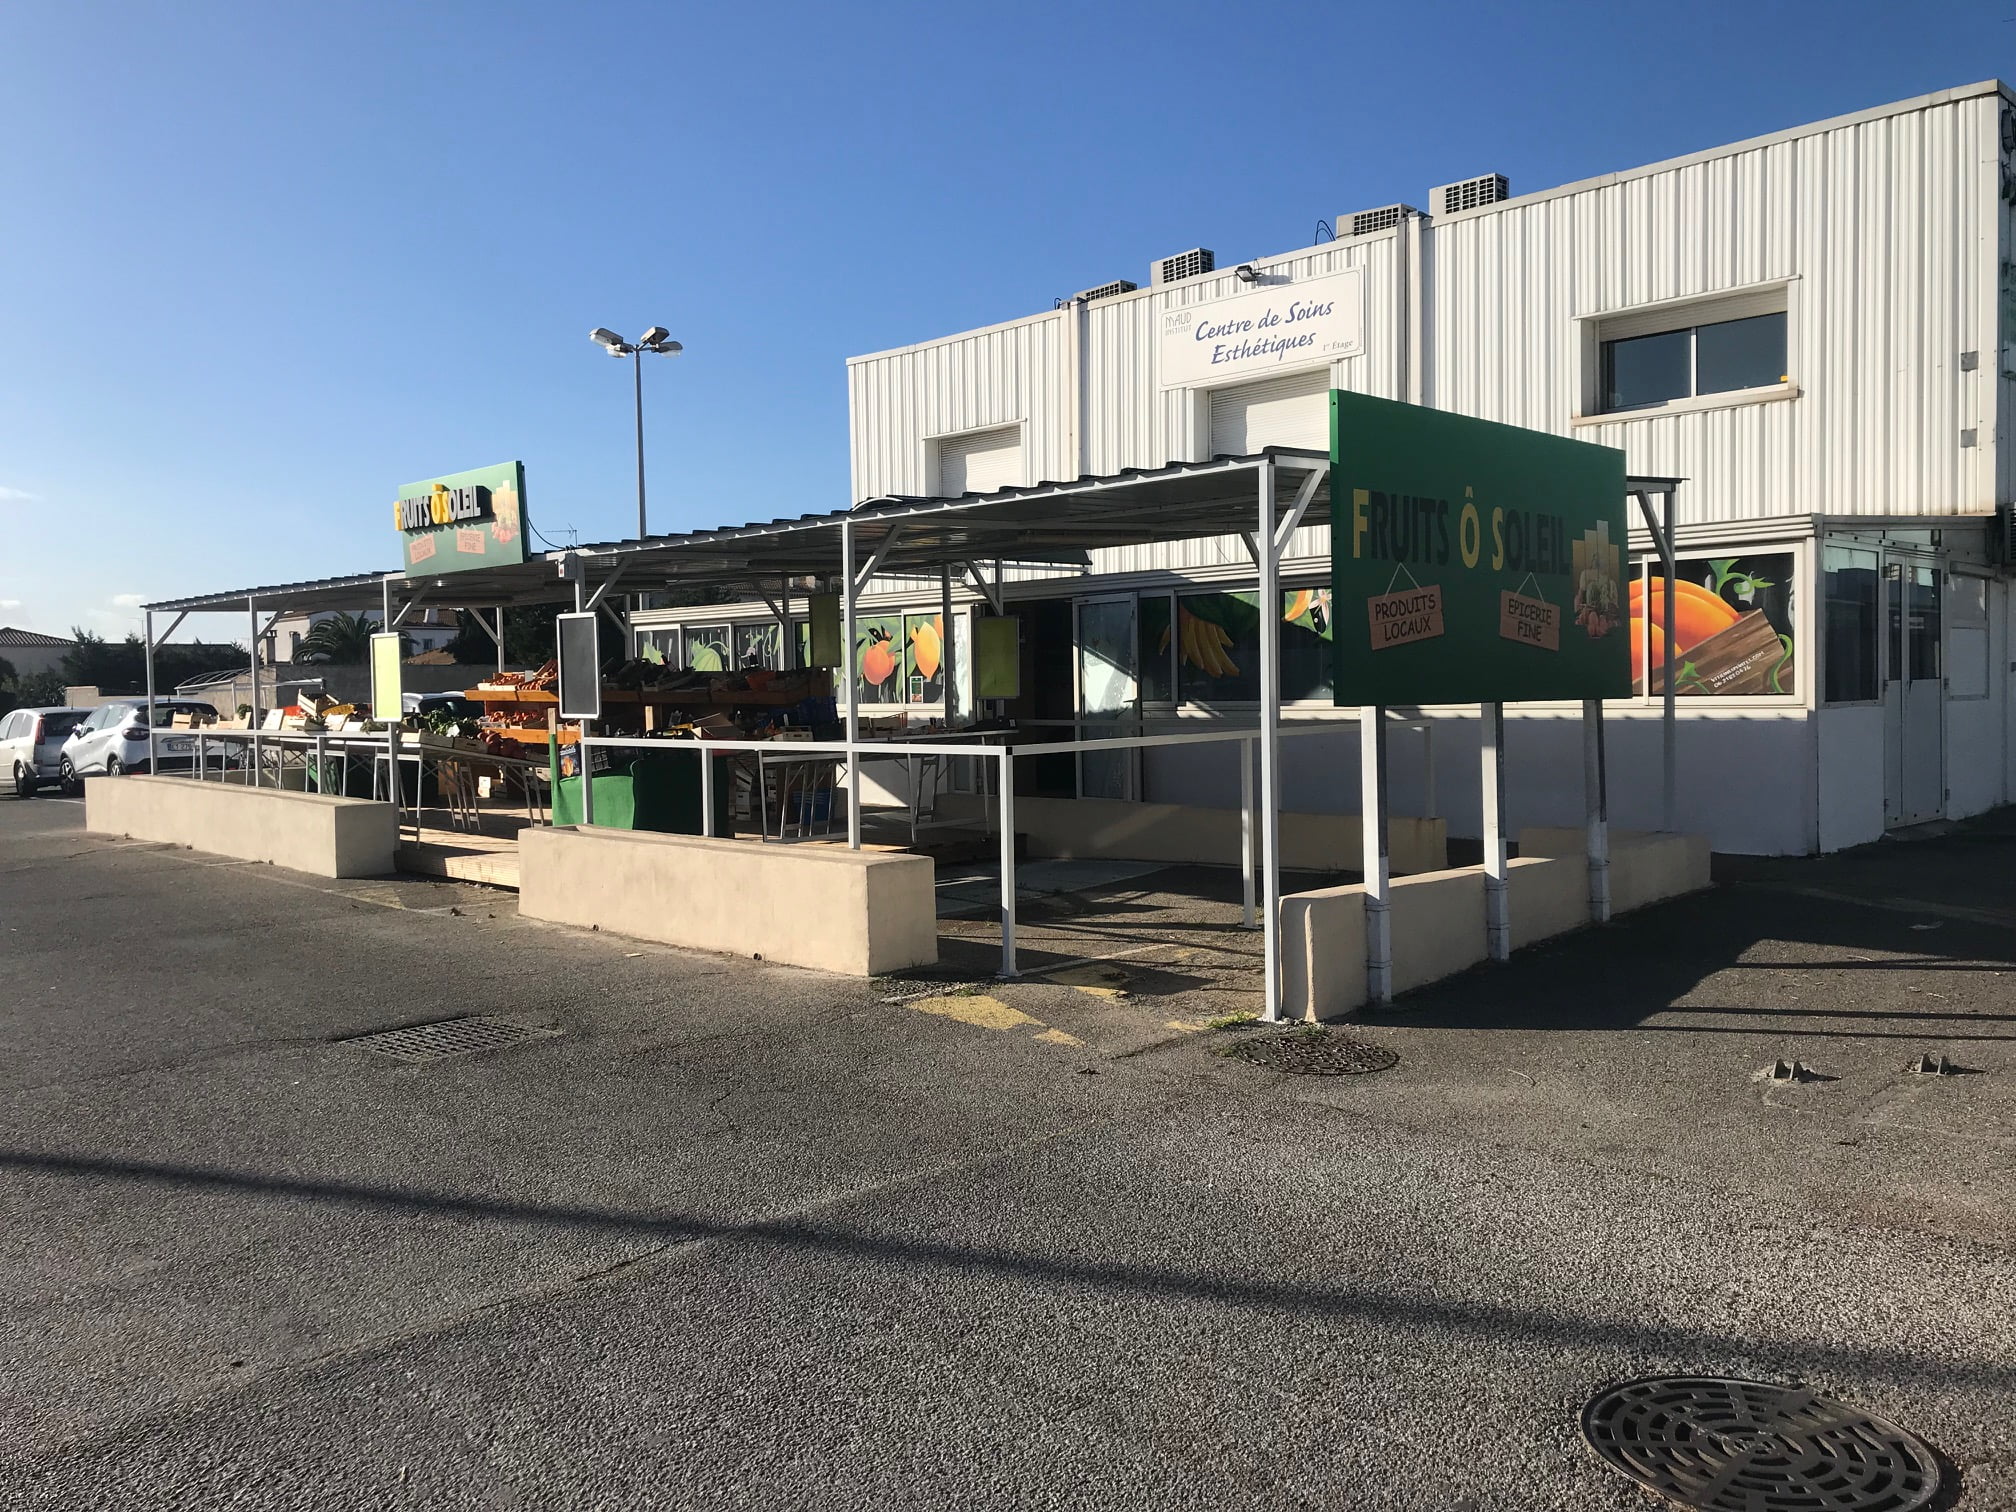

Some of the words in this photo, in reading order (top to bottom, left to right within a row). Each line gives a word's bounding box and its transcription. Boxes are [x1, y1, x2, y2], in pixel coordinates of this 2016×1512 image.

[1165, 311, 1192, 329] MAUD
[1195, 319, 1254, 341] Centre
[1258, 308, 1282, 329] de
[1285, 300, 1335, 324] Soins
[1211, 332, 1317, 364] Esthétiques
[393, 495, 430, 531] FRUITS
[431, 484, 442, 524] Ô
[442, 485, 481, 523] SOLEIL
[1353, 488, 1449, 566] FRUITS
[1460, 486, 1480, 568] Ô
[1492, 506, 1570, 575] SOLEIL
[1375, 594, 1436, 619] PRODUITS
[1508, 598, 1552, 626] EPICERIE
[1383, 617, 1432, 642] LOCAUX
[1517, 624, 1542, 642] FINE
